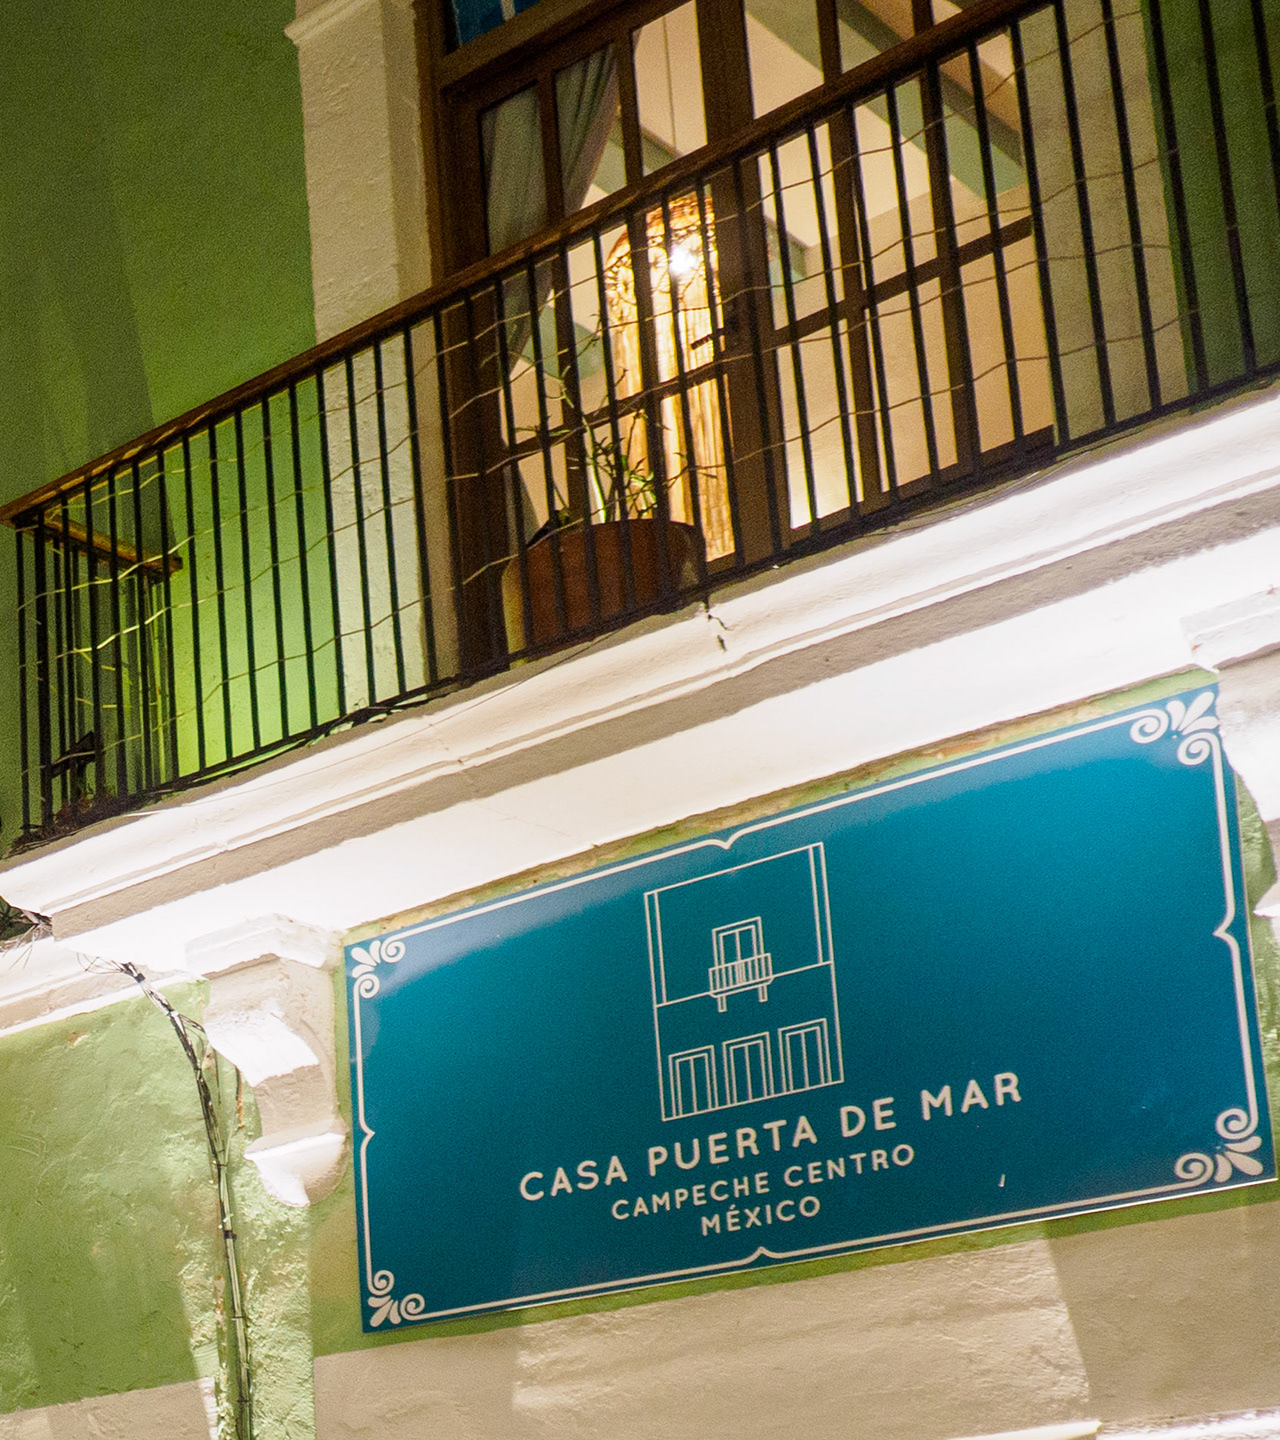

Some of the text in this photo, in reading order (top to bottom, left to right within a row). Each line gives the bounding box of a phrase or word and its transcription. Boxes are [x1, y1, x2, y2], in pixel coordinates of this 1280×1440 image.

[519, 1071, 1022, 1201] CASA PUERTA DE MAR
[611, 1144, 915, 1221] CAMPECHE CENTRO
[701, 1196, 820, 1236] MÉXICO
